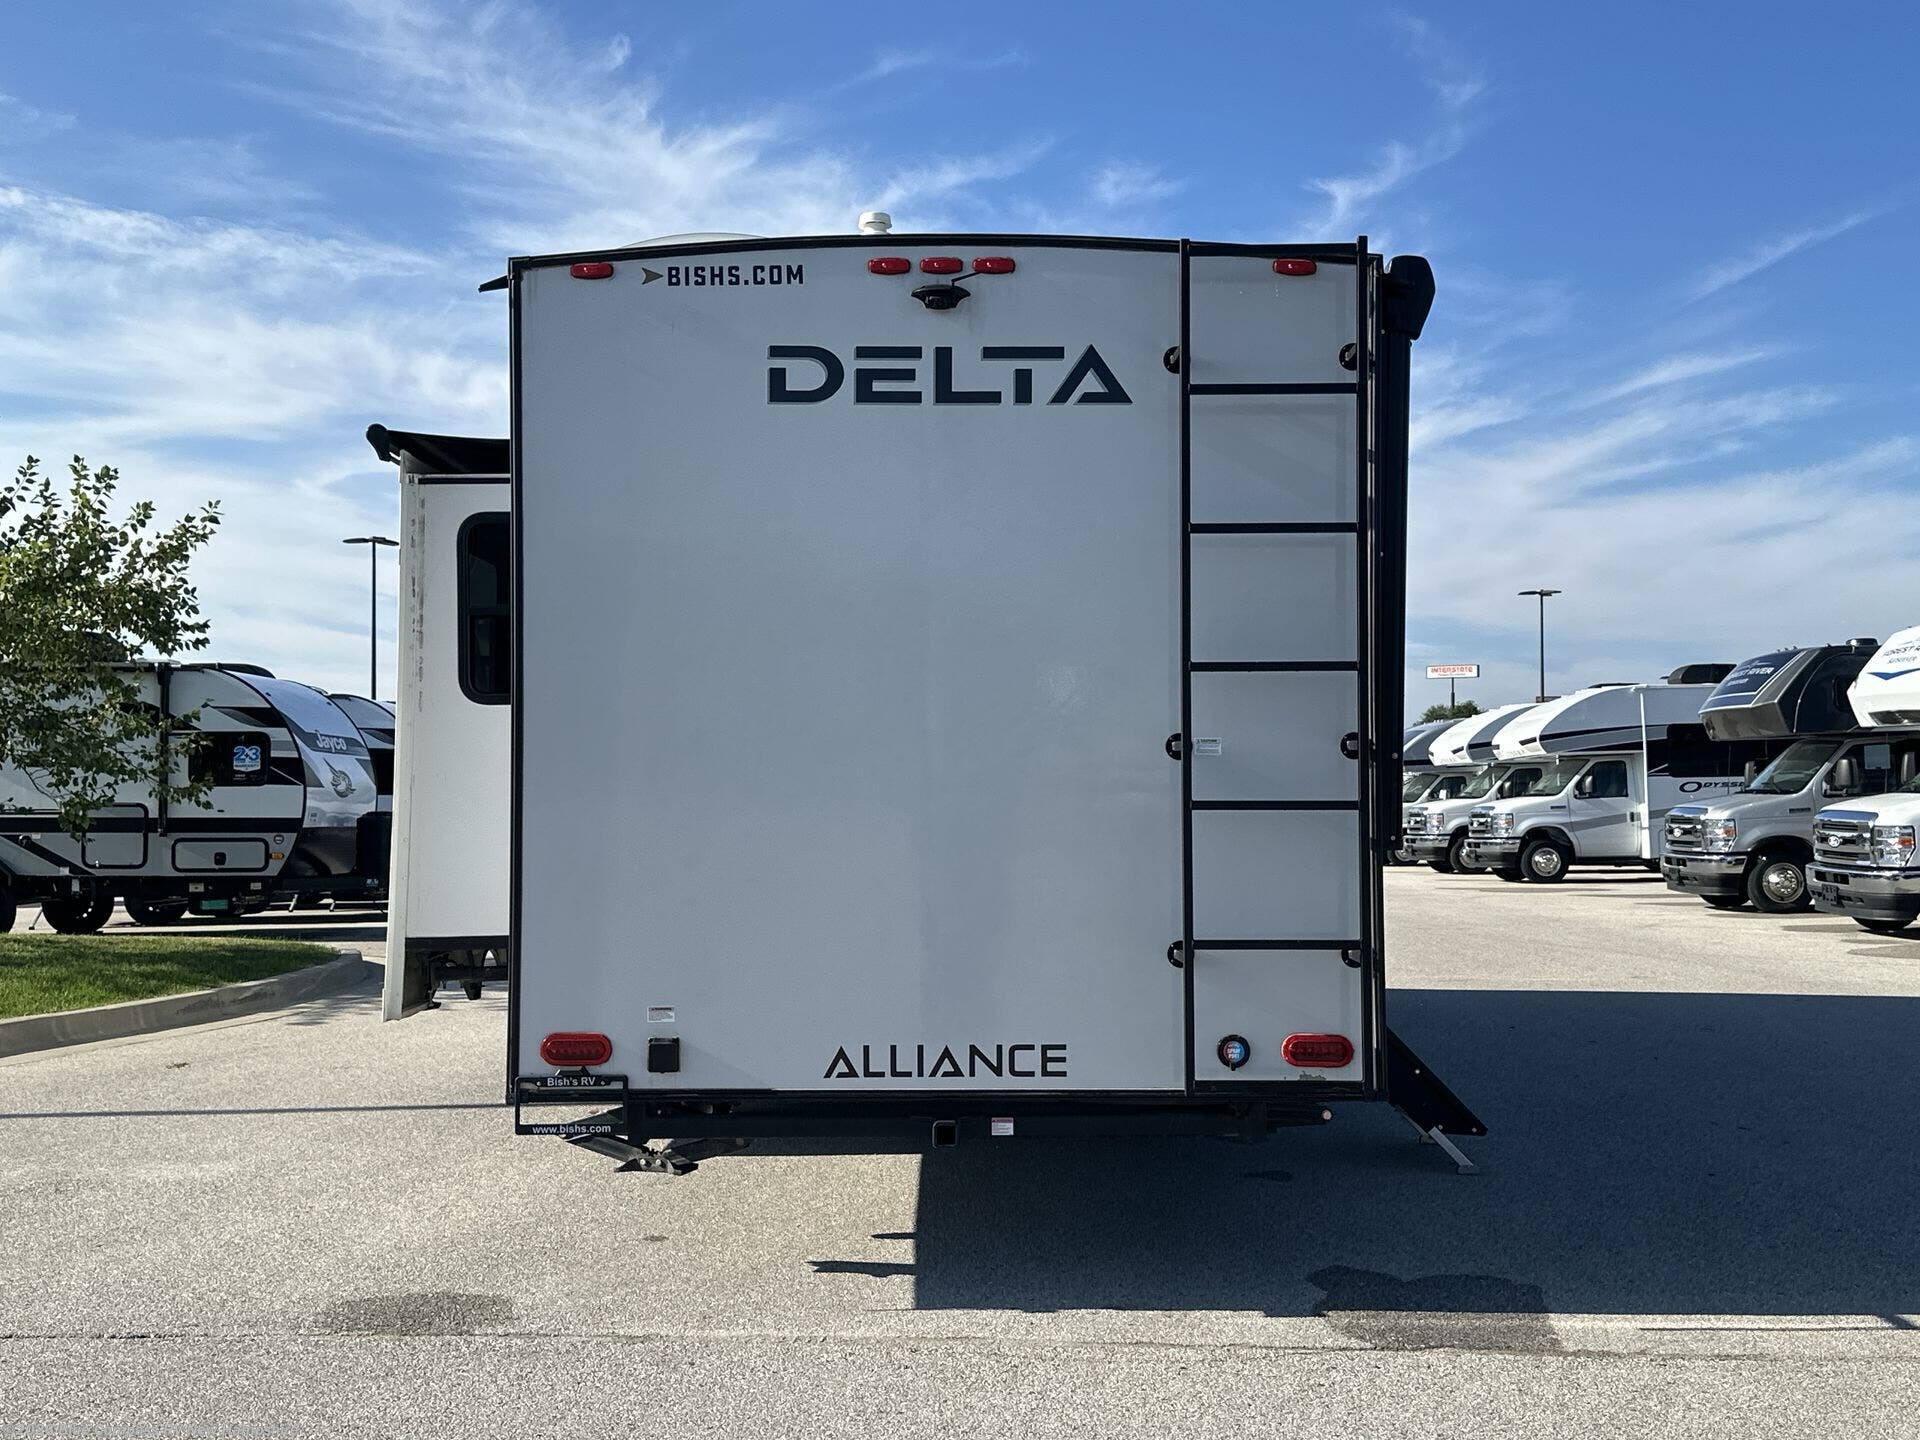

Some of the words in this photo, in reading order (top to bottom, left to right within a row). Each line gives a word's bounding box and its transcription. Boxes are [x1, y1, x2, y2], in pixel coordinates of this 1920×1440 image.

[667, 264, 804, 287] BISHS.COM
[767, 344, 1133, 406] DELTA
[316, 731, 347, 753] Jayco
[824, 1044, 1067, 1078] ALLIANCE
[546, 1077, 579, 1087] Bish's
[580, 1076, 596, 1086] RV
[531, 1124, 612, 1134] www.bishs.com
